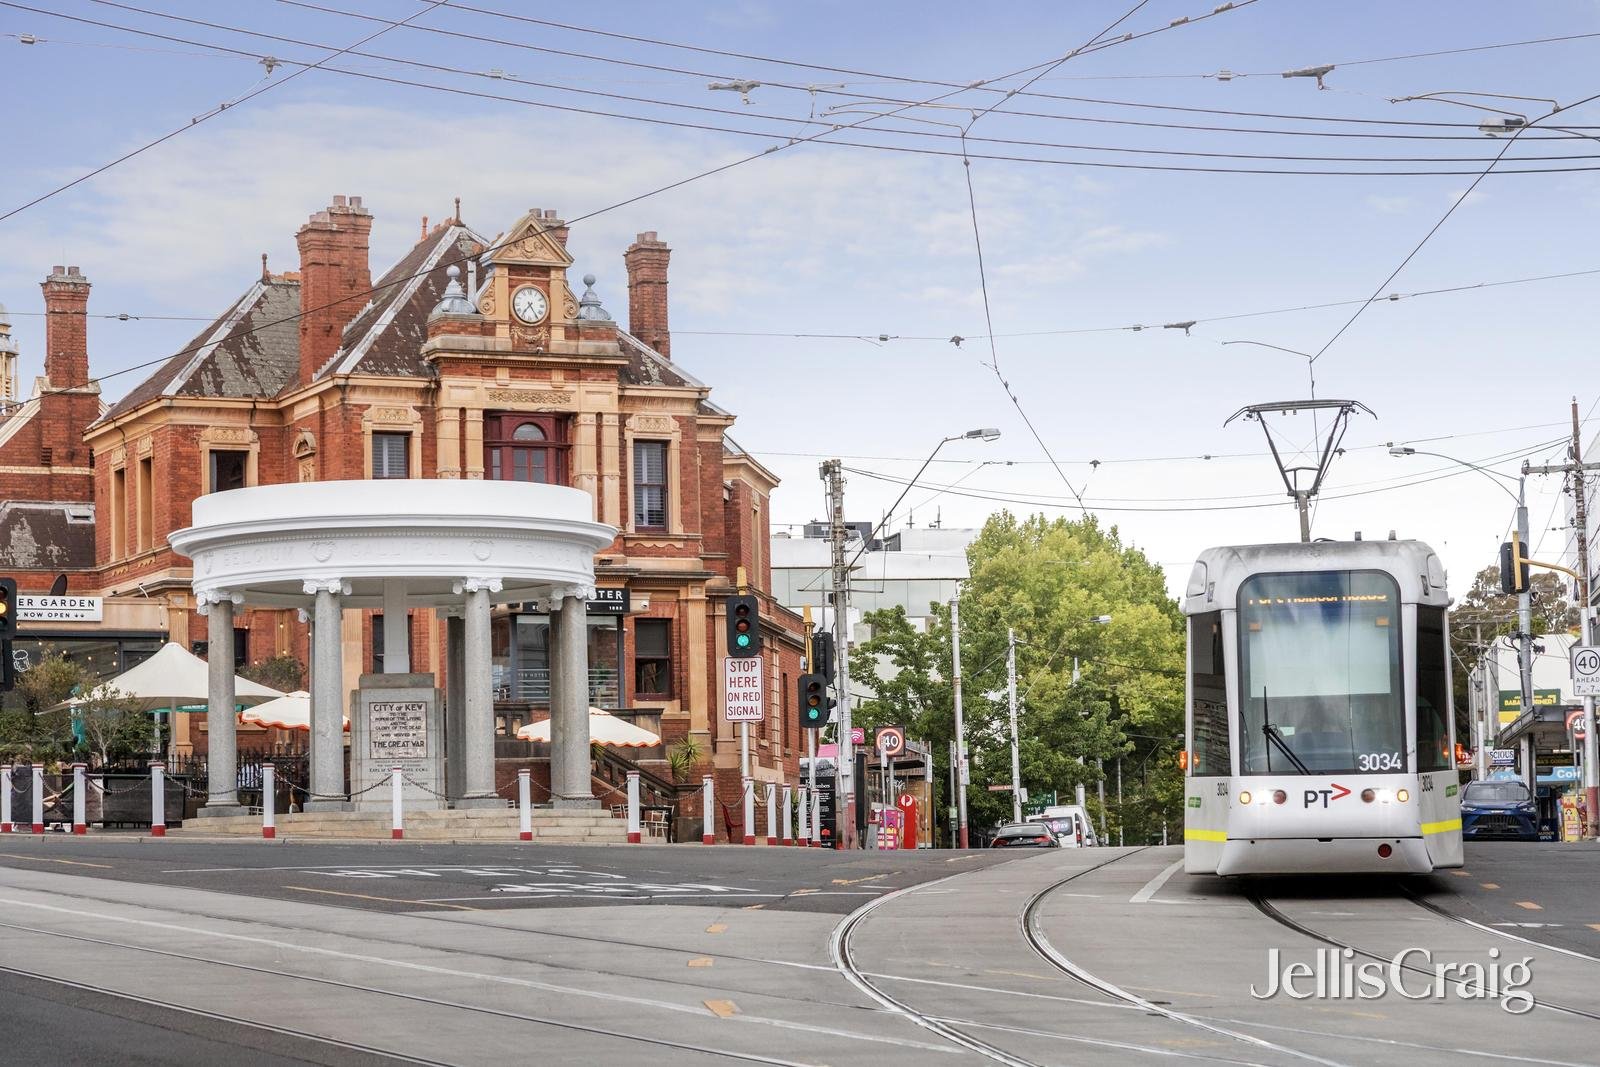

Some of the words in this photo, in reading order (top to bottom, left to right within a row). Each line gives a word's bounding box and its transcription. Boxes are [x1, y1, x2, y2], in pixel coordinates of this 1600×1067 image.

[40, 598, 95, 607] GARDEN
[730, 660, 757, 672] STOP
[1578, 656, 1598, 669] 40
[729, 677, 758, 688] HERE
[727, 692, 740, 702] ON
[742, 691, 761, 701] RED
[373, 704, 394, 712] CITY
[404, 703, 423, 711] KEW
[727, 705, 761, 716] SIGNAL
[883, 736, 899, 748] 40
[1358, 752, 1402, 771] 3034
